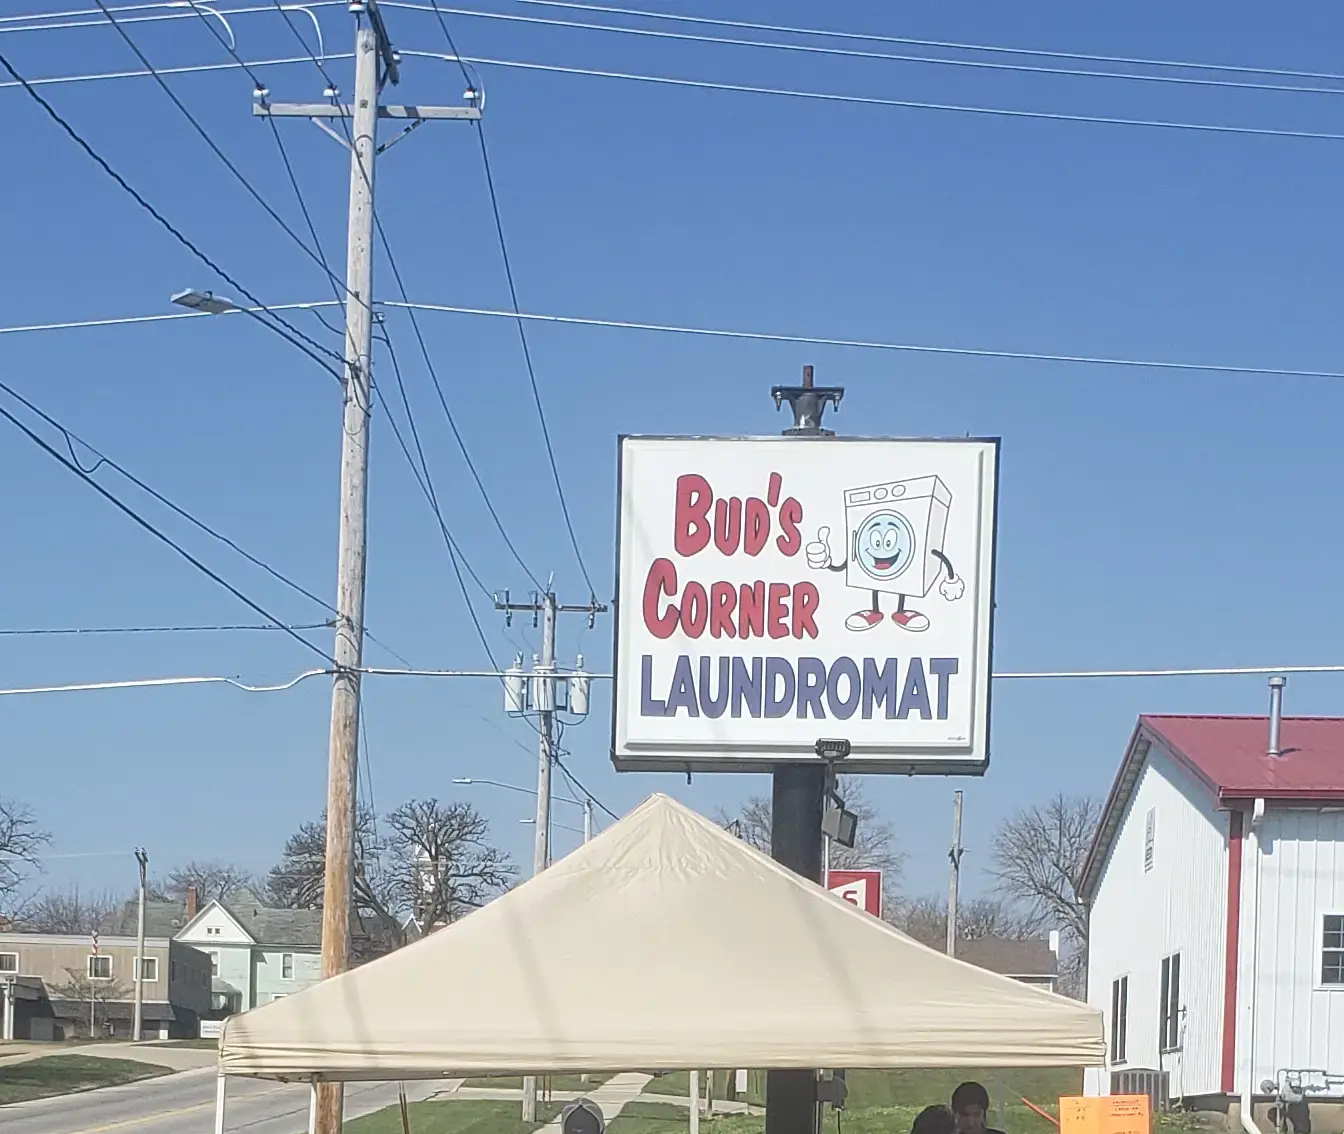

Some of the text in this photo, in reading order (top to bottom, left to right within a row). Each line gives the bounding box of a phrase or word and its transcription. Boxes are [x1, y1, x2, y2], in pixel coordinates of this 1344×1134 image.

[674, 472, 803, 557] BUD'S
[642, 557, 820, 640] CORNER
[640, 654, 959, 720] LAUNDROMAT
